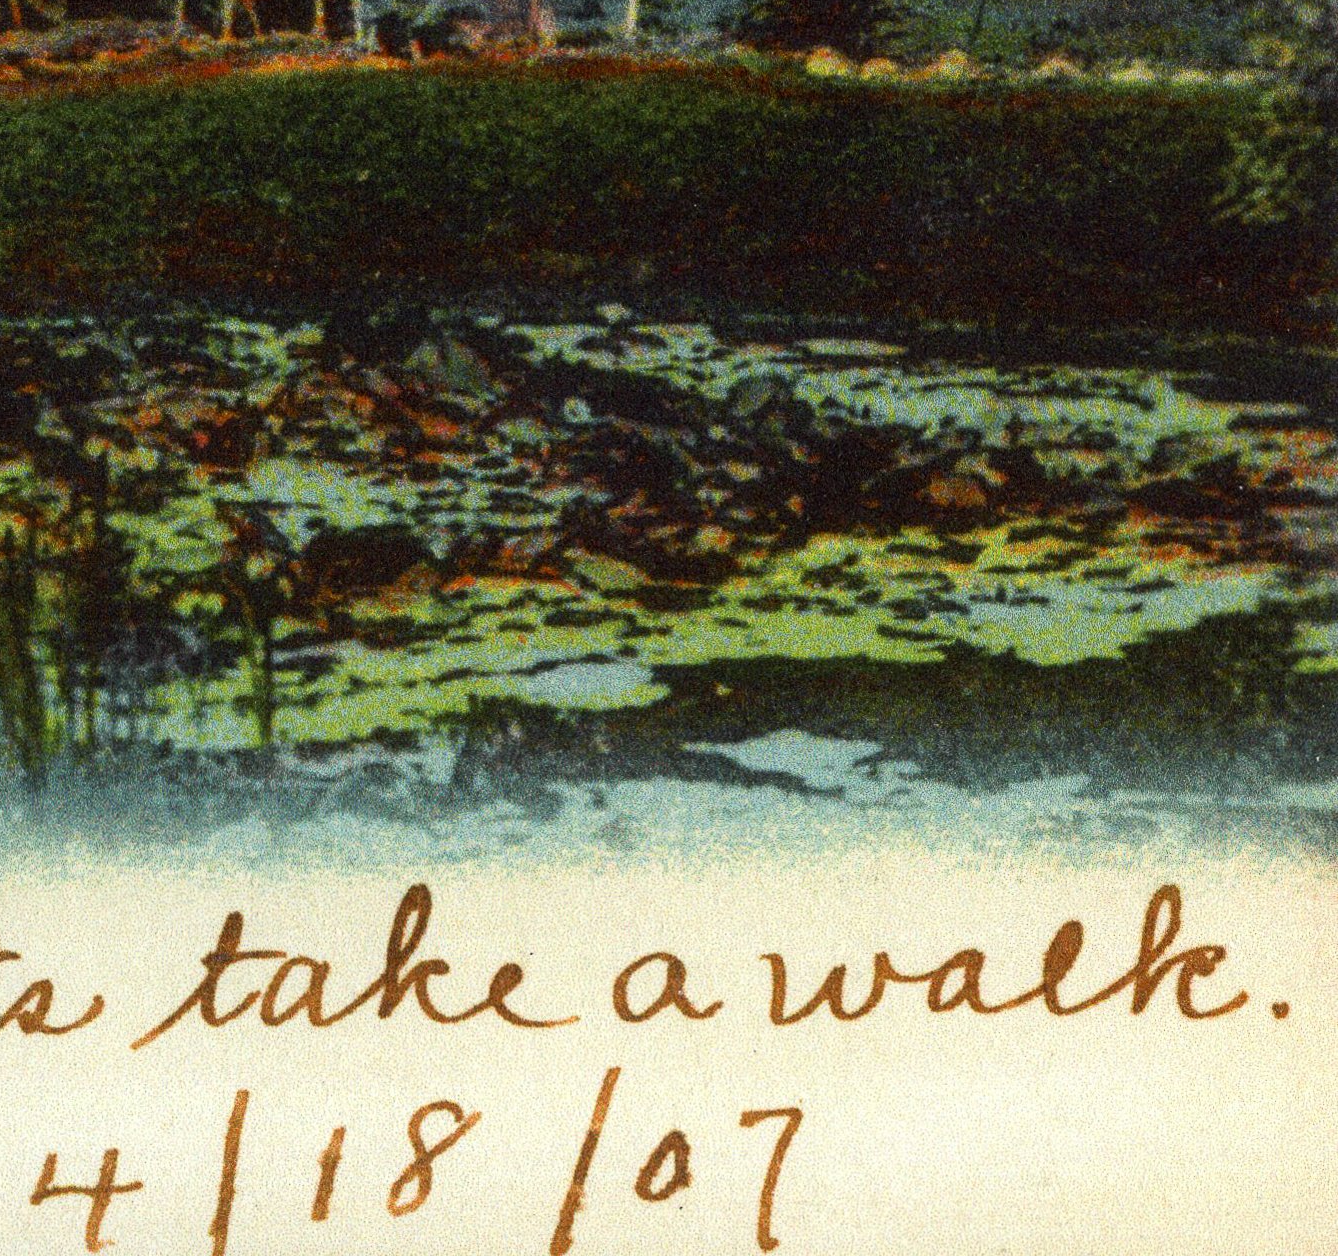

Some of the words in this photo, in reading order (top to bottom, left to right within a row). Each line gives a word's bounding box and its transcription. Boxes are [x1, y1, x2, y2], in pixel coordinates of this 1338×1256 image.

[131, 885, 579, 1050] take
[612, 952, 722, 1023] a
[760, 885, 1290, 1027] walk.
[30, 1067, 803, 1255] 4/18/07
